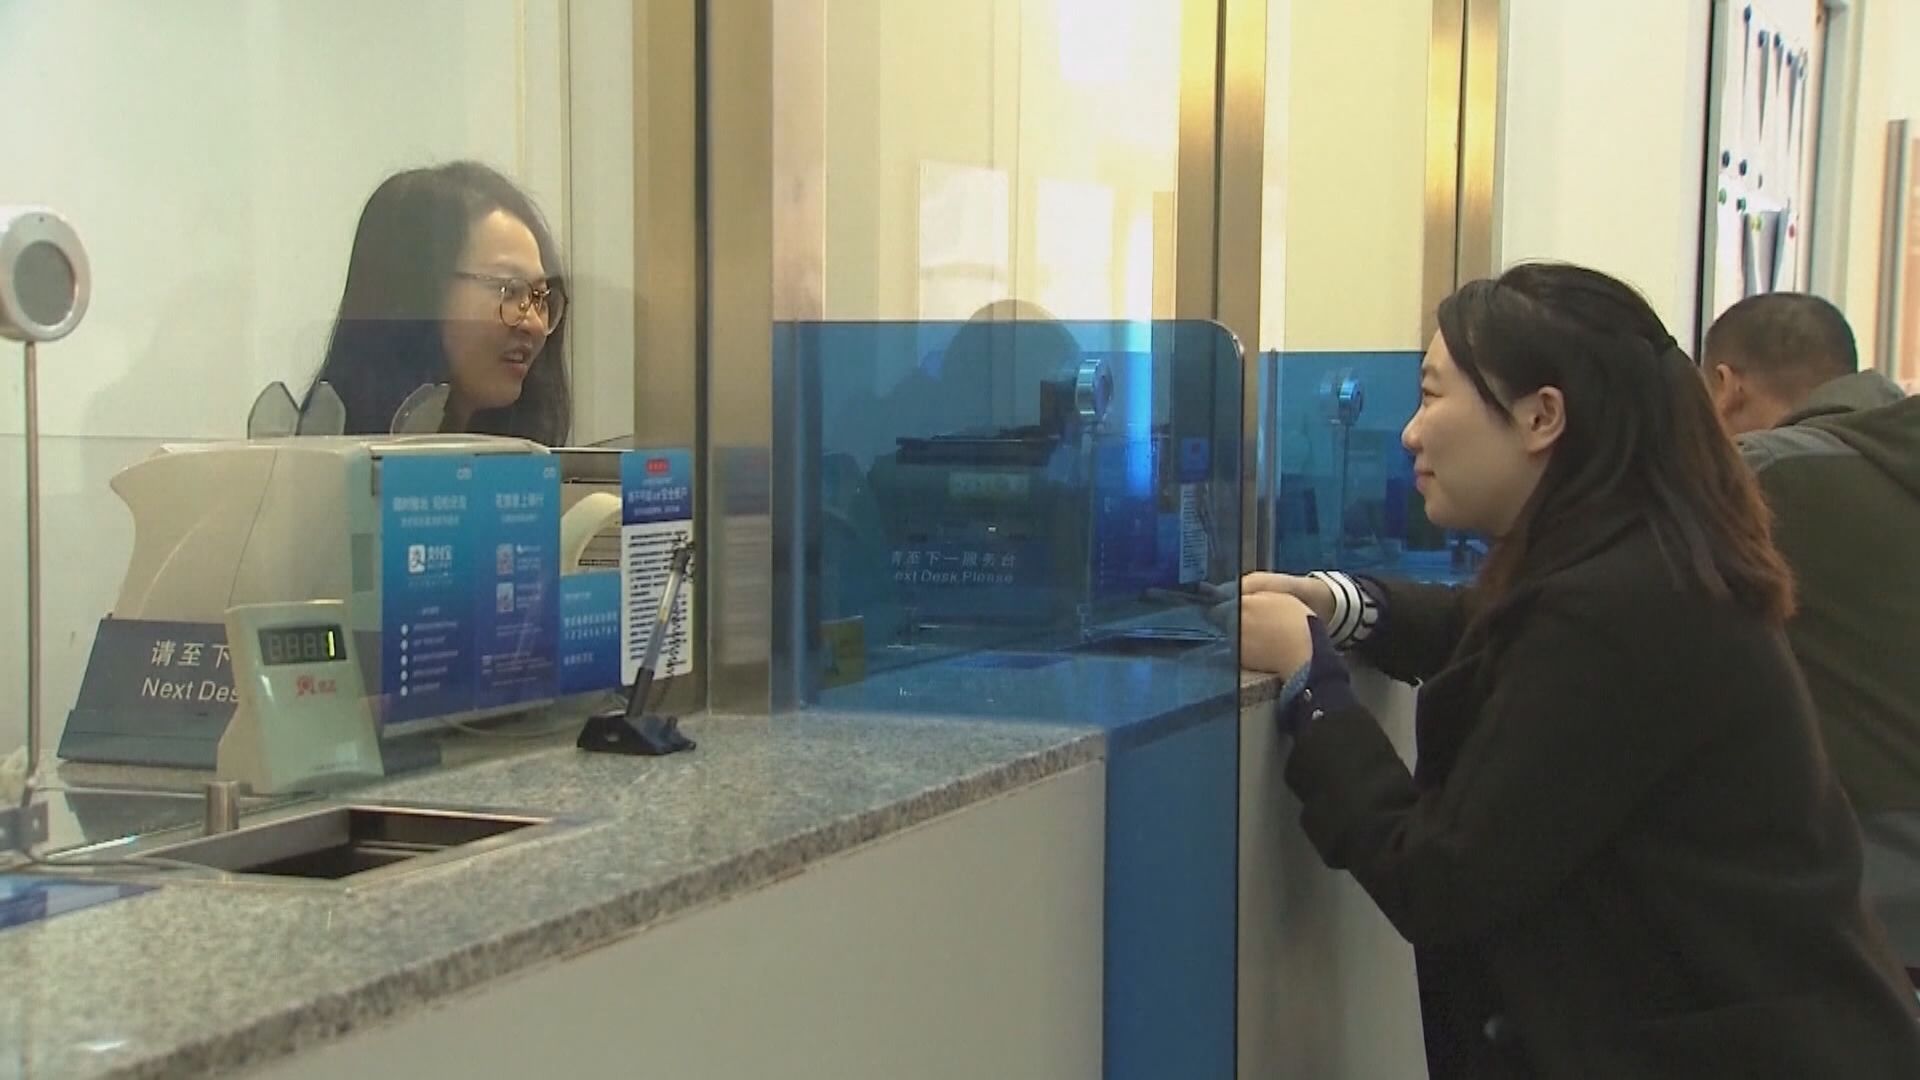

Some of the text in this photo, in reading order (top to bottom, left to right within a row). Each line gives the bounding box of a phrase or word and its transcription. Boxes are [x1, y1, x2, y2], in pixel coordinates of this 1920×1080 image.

[151, 639, 230, 669] 请至下
[142, 677, 194, 700] Next
